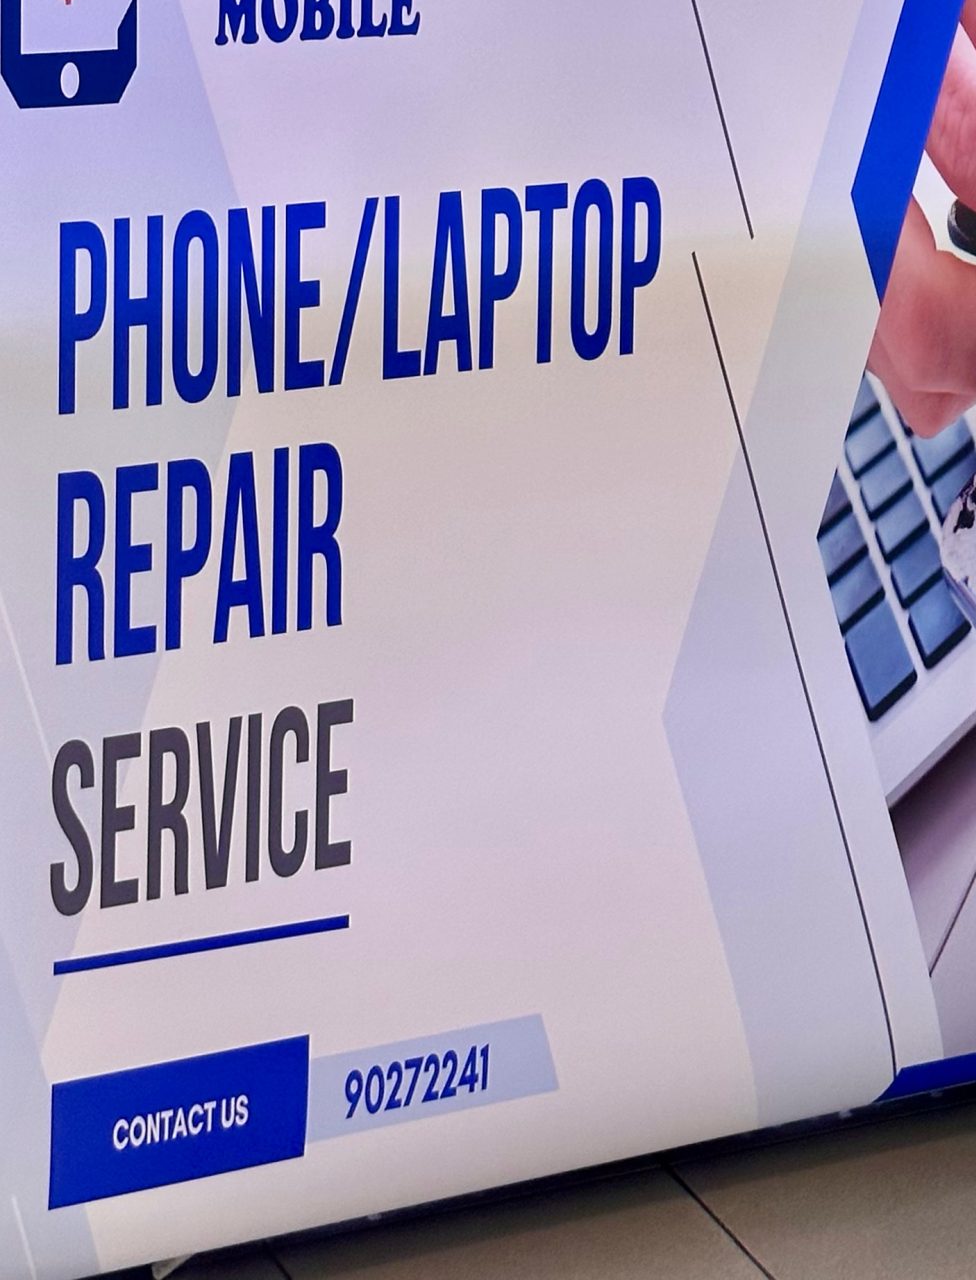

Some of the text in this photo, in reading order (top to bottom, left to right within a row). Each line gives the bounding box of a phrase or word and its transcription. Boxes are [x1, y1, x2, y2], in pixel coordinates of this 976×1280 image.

[58, 176, 662, 415] PHONE/LAPTOP
[55, 442, 344, 666] REPAIR
[50, 698, 355, 917] SERVICE
[112, 1094, 249, 1150] CONTACT US
[344, 1043, 490, 1120] 90272241
